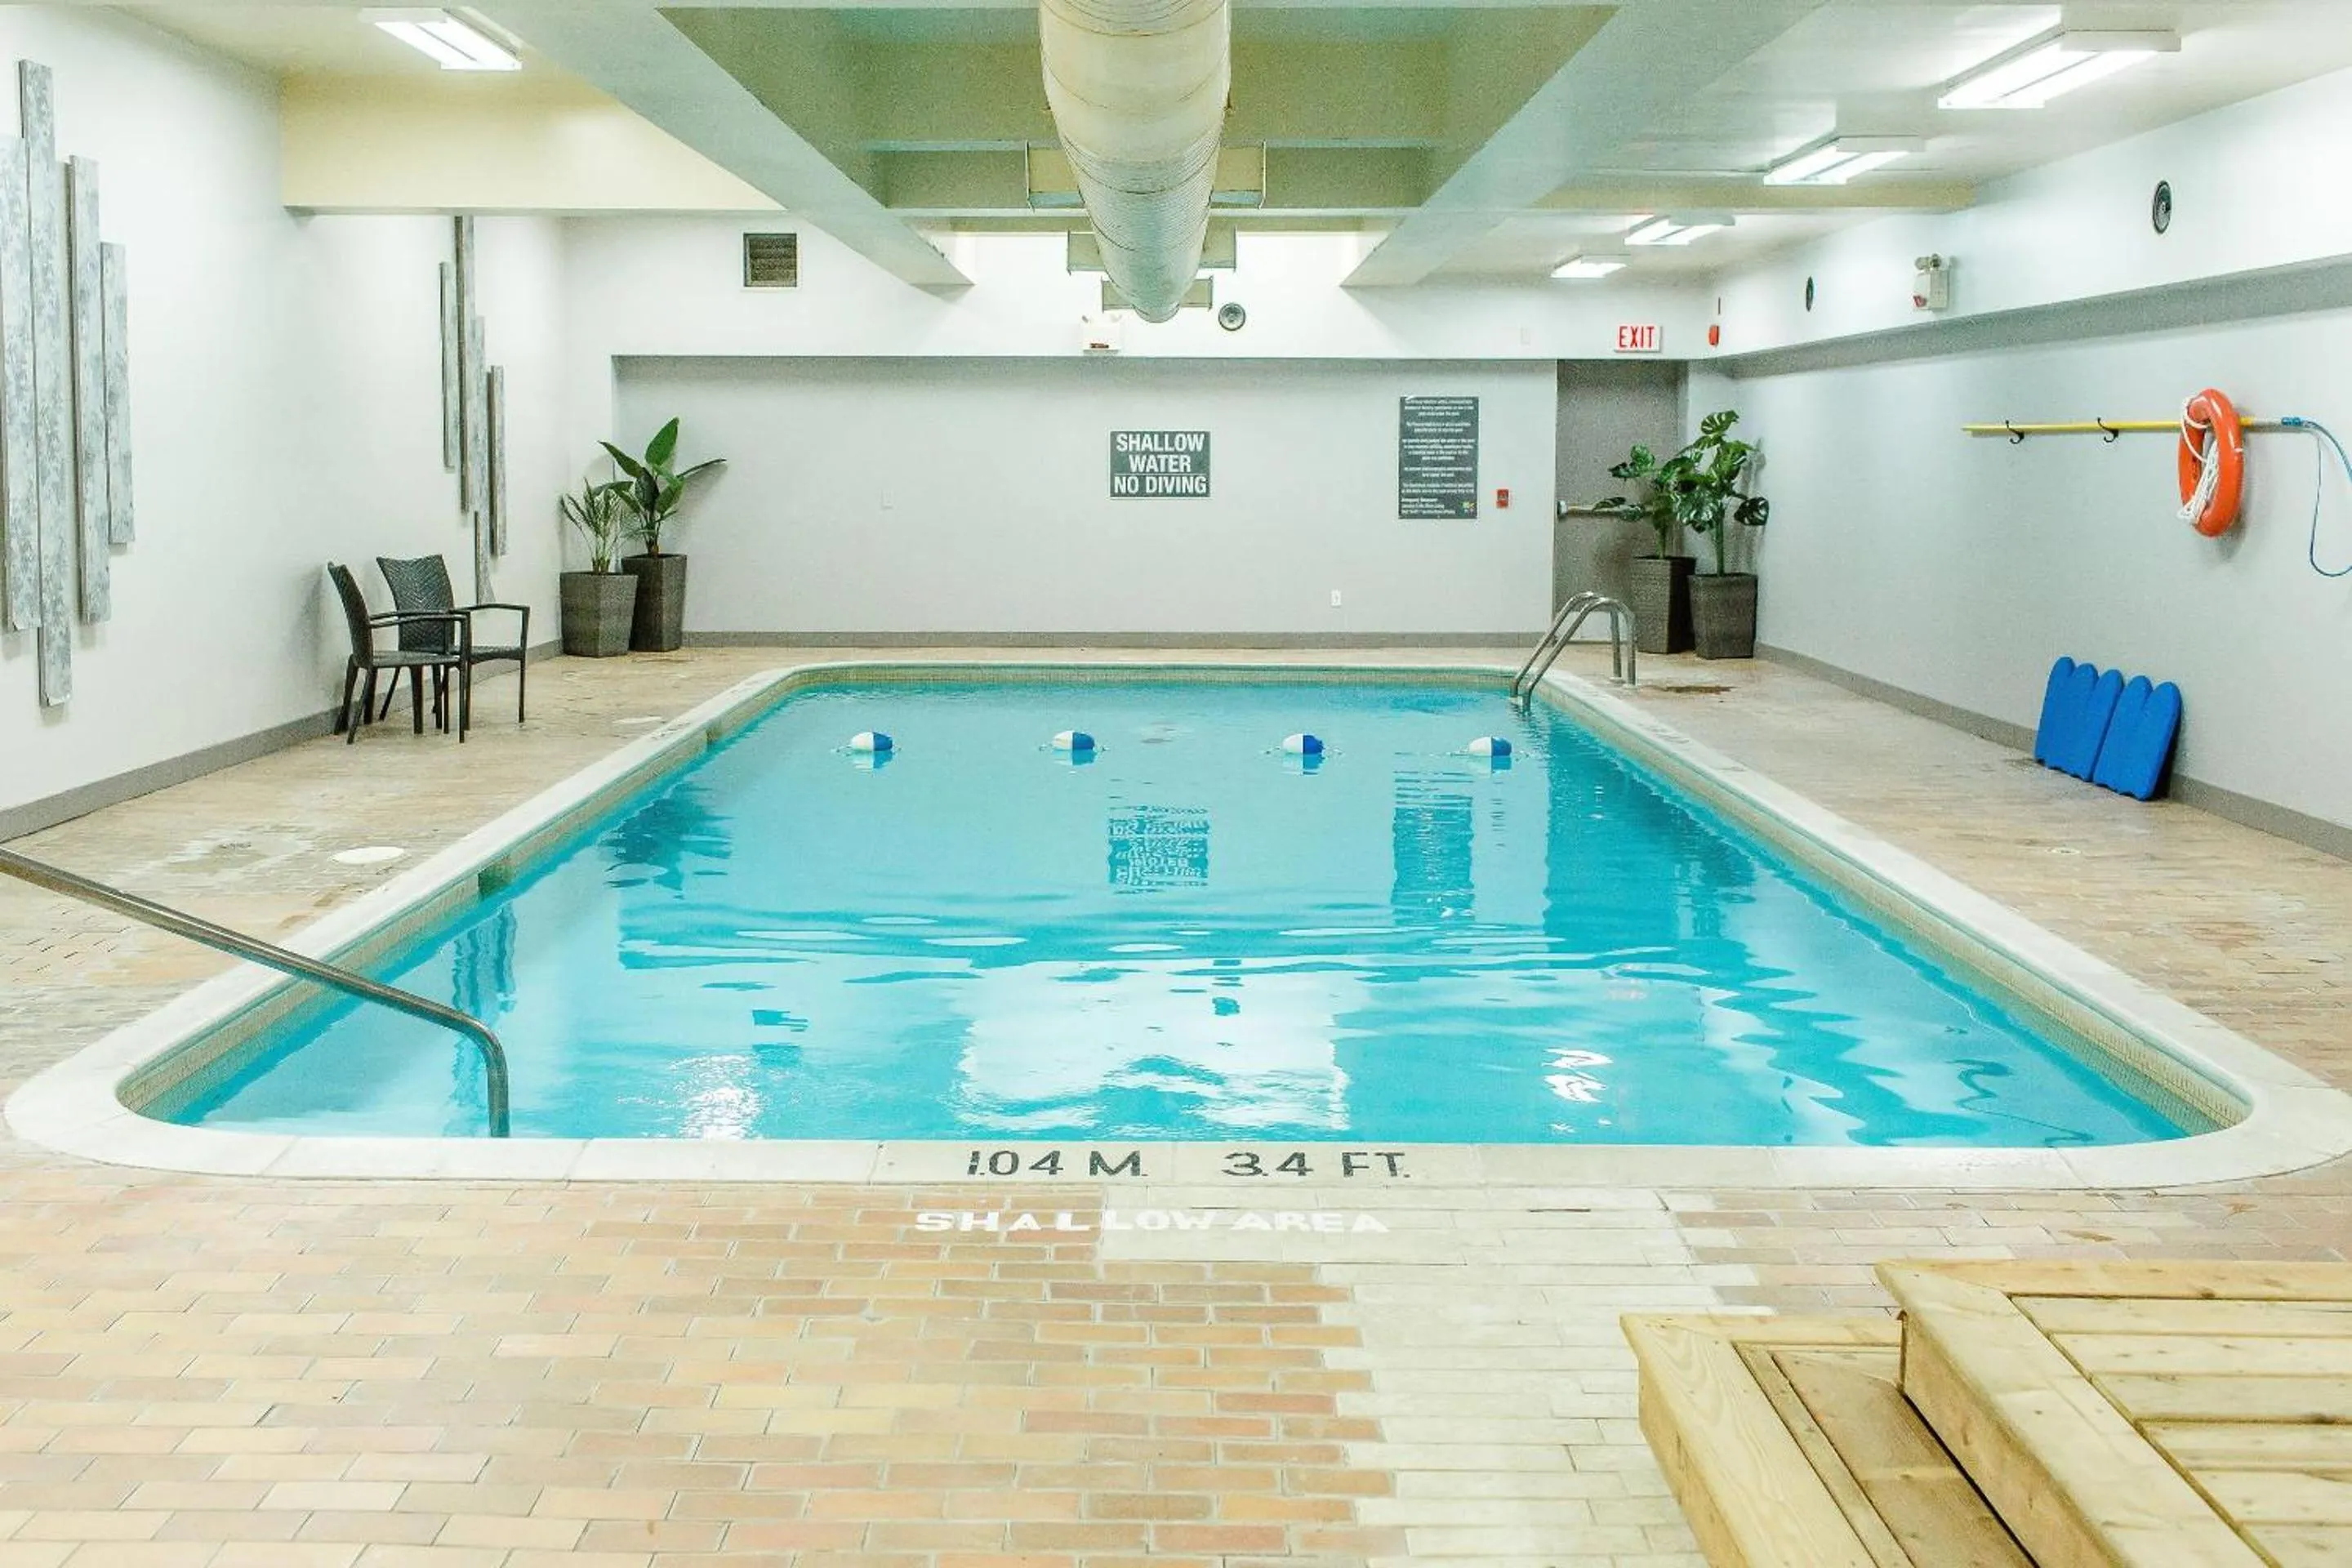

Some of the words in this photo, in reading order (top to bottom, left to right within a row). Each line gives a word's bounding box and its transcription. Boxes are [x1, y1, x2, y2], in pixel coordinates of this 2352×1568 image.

[1619, 325, 1655, 348] EXIT
[1116, 433, 1205, 452] SHALLOW
[1129, 454, 1192, 473] WATER
[1114, 475, 1139, 494] NO
[1145, 475, 1207, 494] DIVING
[1221, 1152, 1314, 1177] 3.4
[1341, 1152, 1410, 1178] FT.
[914, 1209, 1217, 1232] SHALLOW
[1229, 1211, 1391, 1233] AREA
